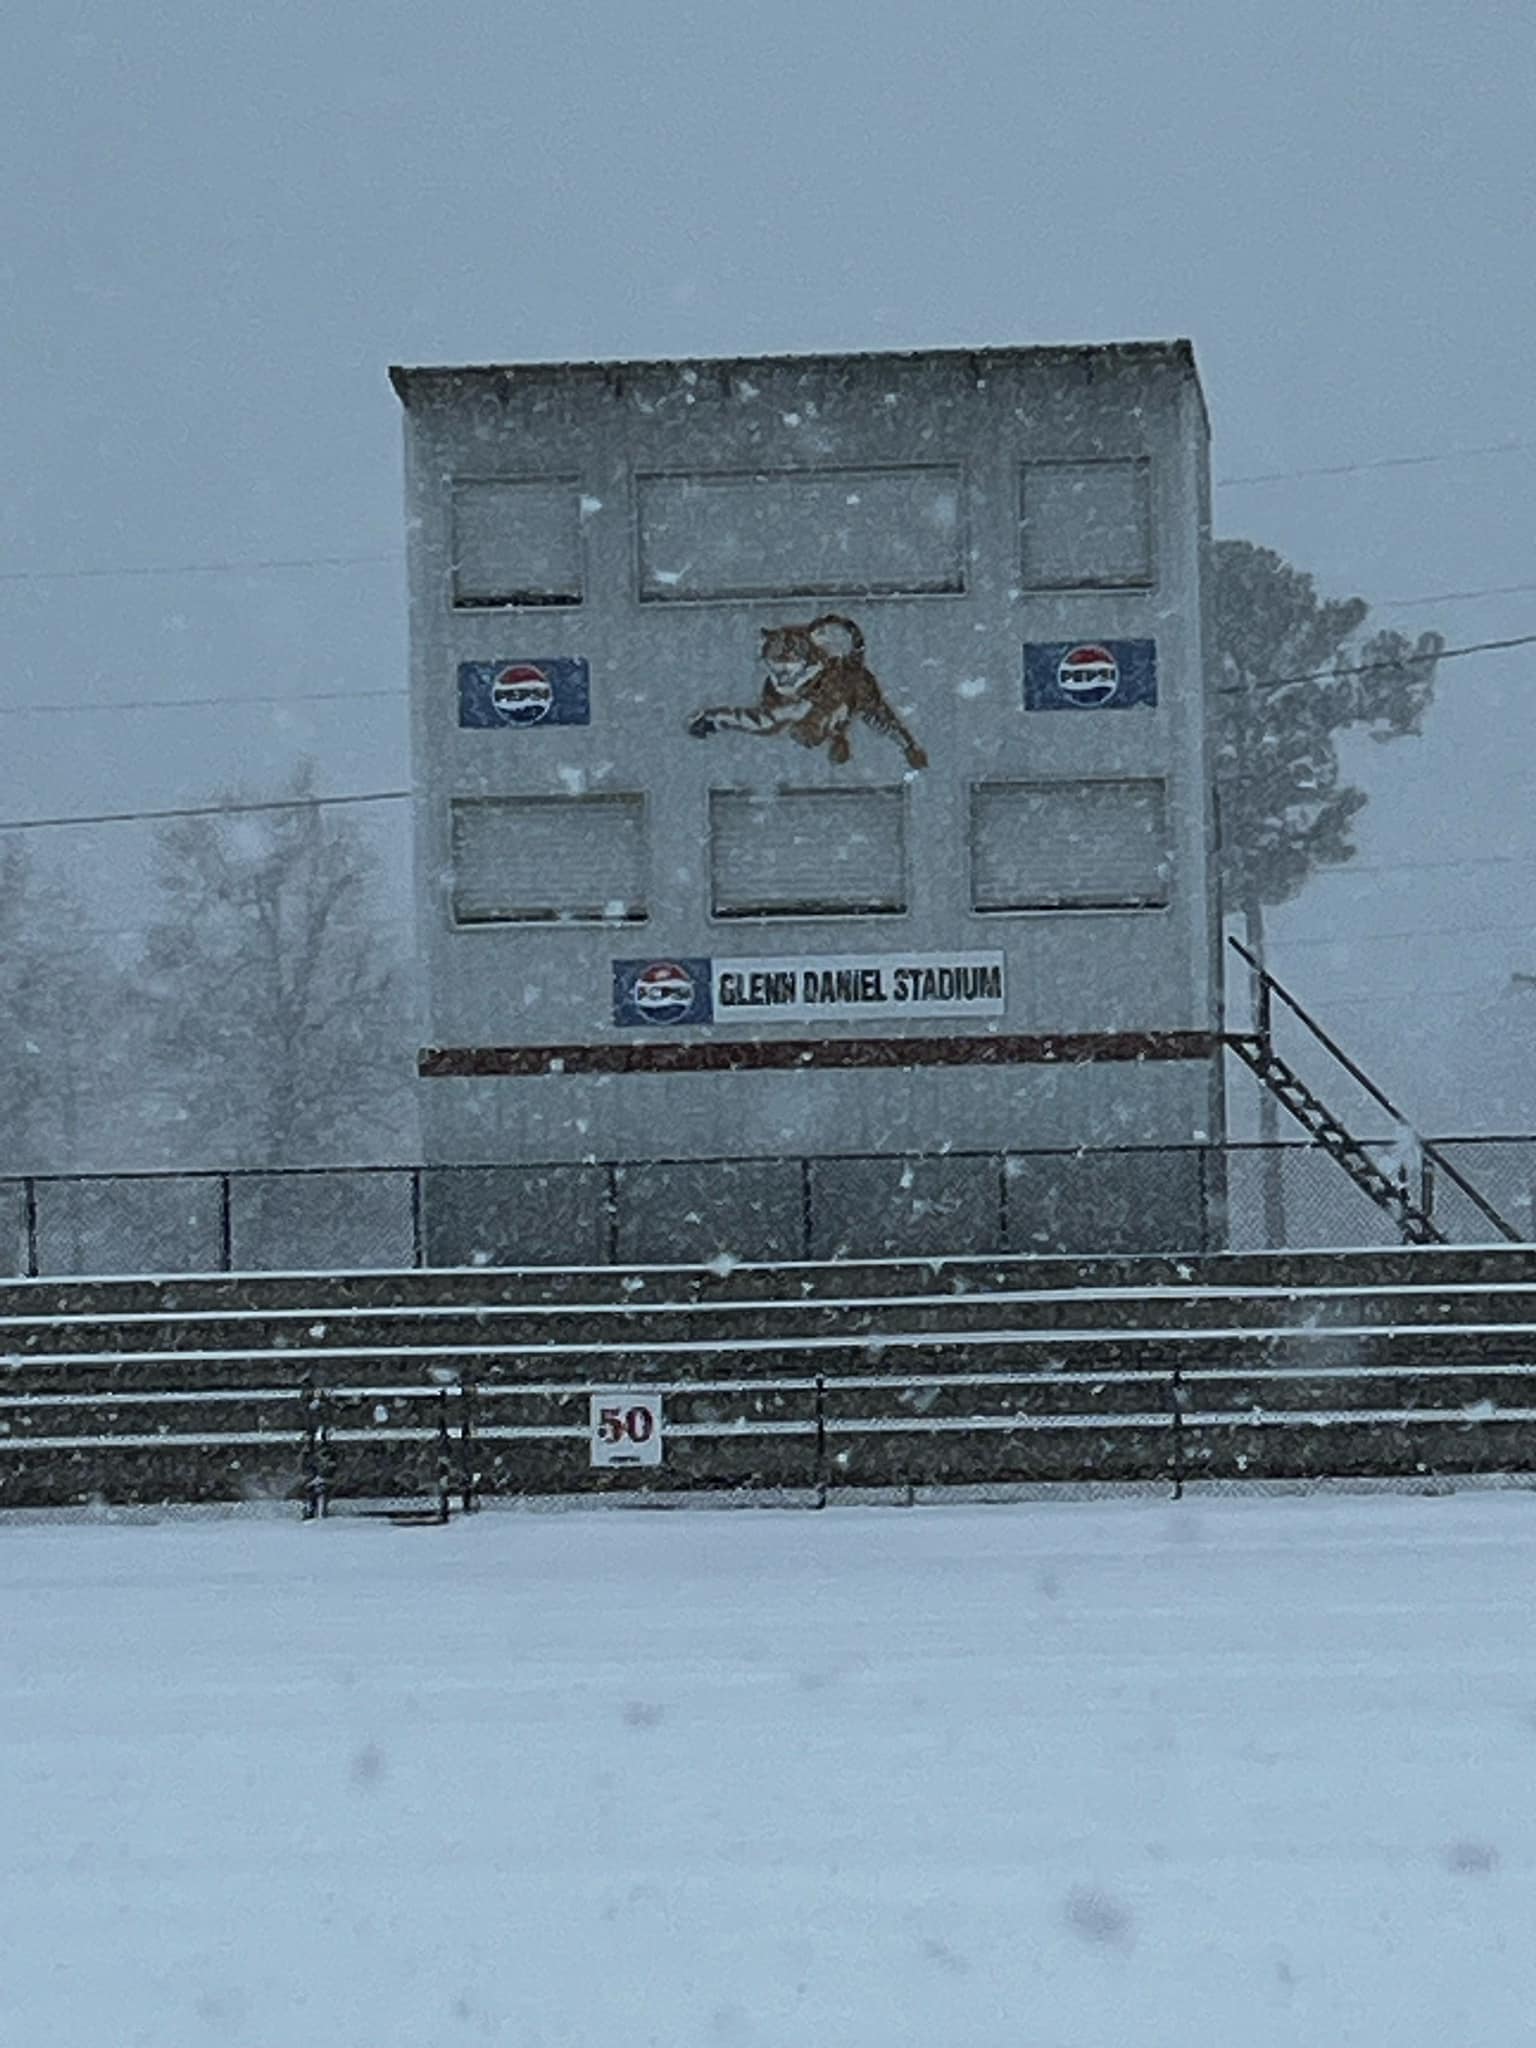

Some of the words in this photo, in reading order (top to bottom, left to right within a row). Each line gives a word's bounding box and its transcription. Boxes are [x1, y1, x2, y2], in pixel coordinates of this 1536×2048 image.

[720, 971, 797, 1006] GLENN
[803, 968, 888, 1004] DANIEL
[893, 965, 1002, 1002] STADIUM
[598, 1405, 654, 1445] 50
